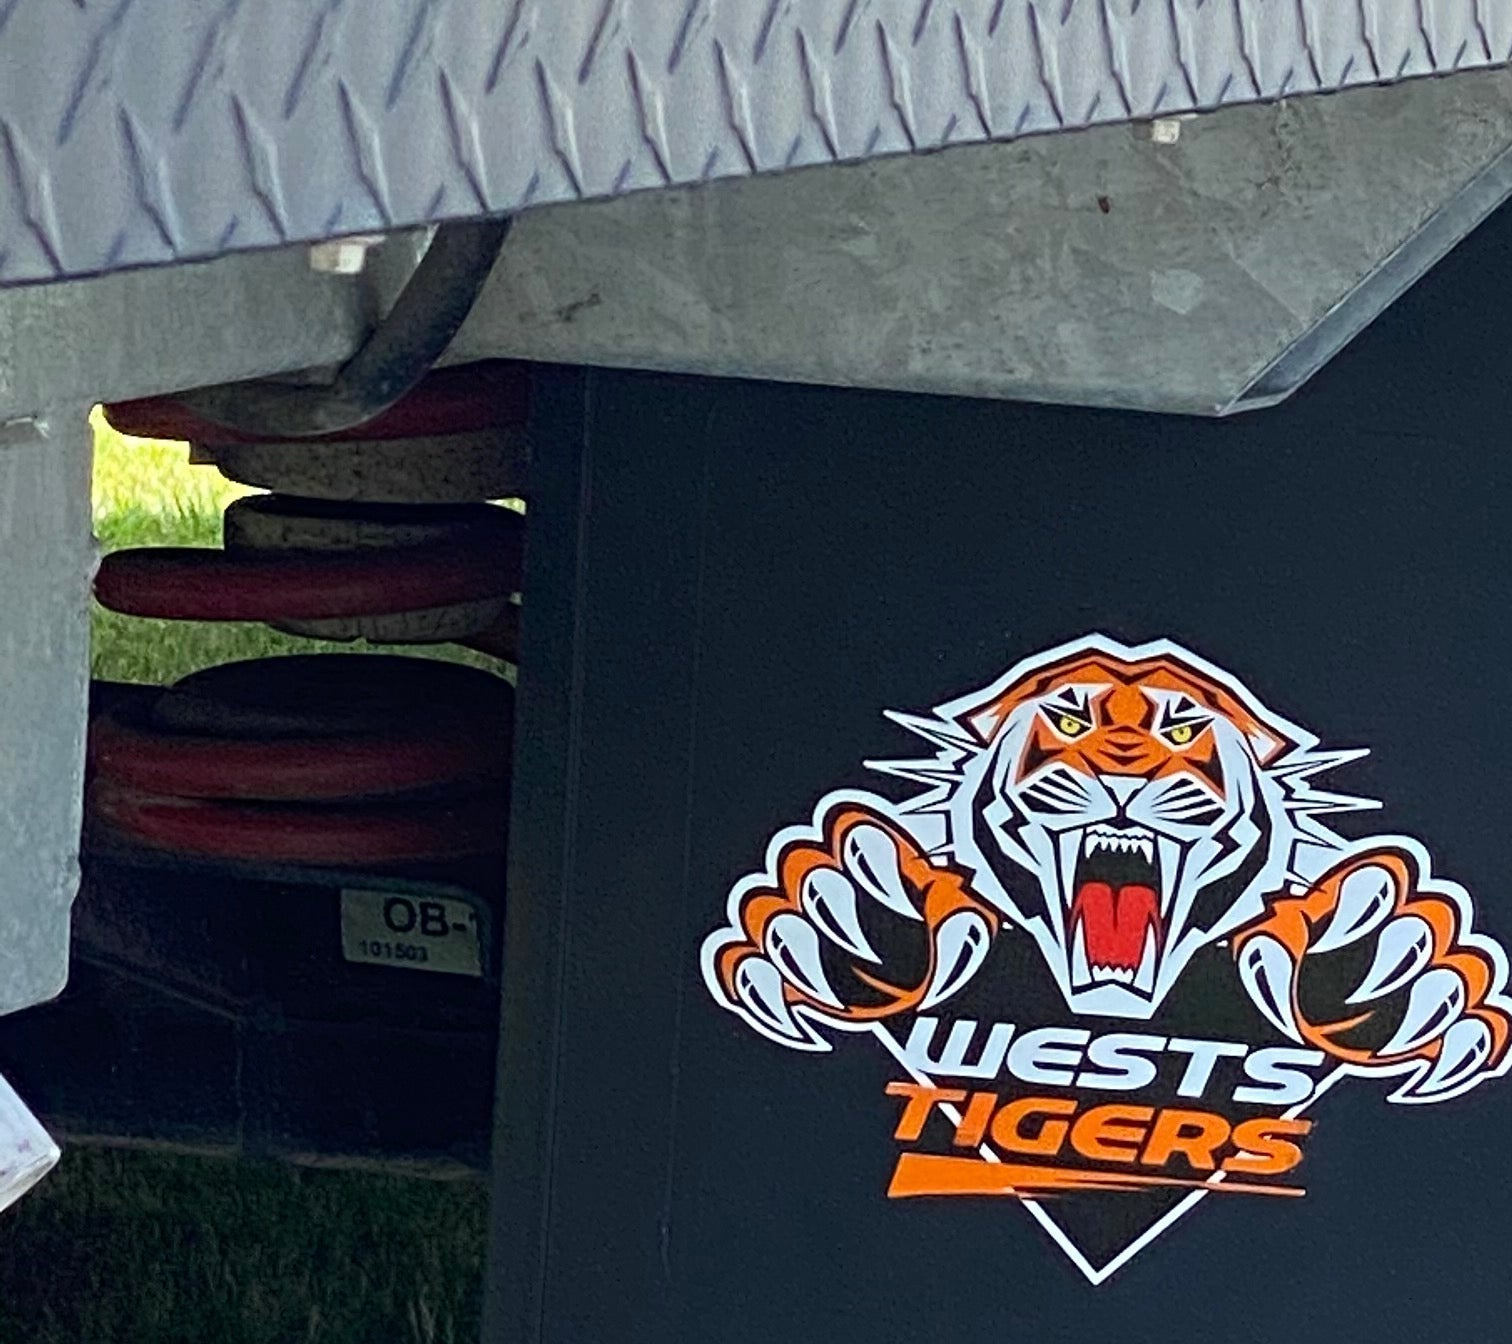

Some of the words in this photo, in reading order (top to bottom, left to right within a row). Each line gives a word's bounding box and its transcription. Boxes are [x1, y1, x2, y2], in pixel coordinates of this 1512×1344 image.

[383, 897, 476, 937] OB-
[903, 1016, 1326, 1106] WESTS
[884, 1082, 1314, 1175] TIGERS
